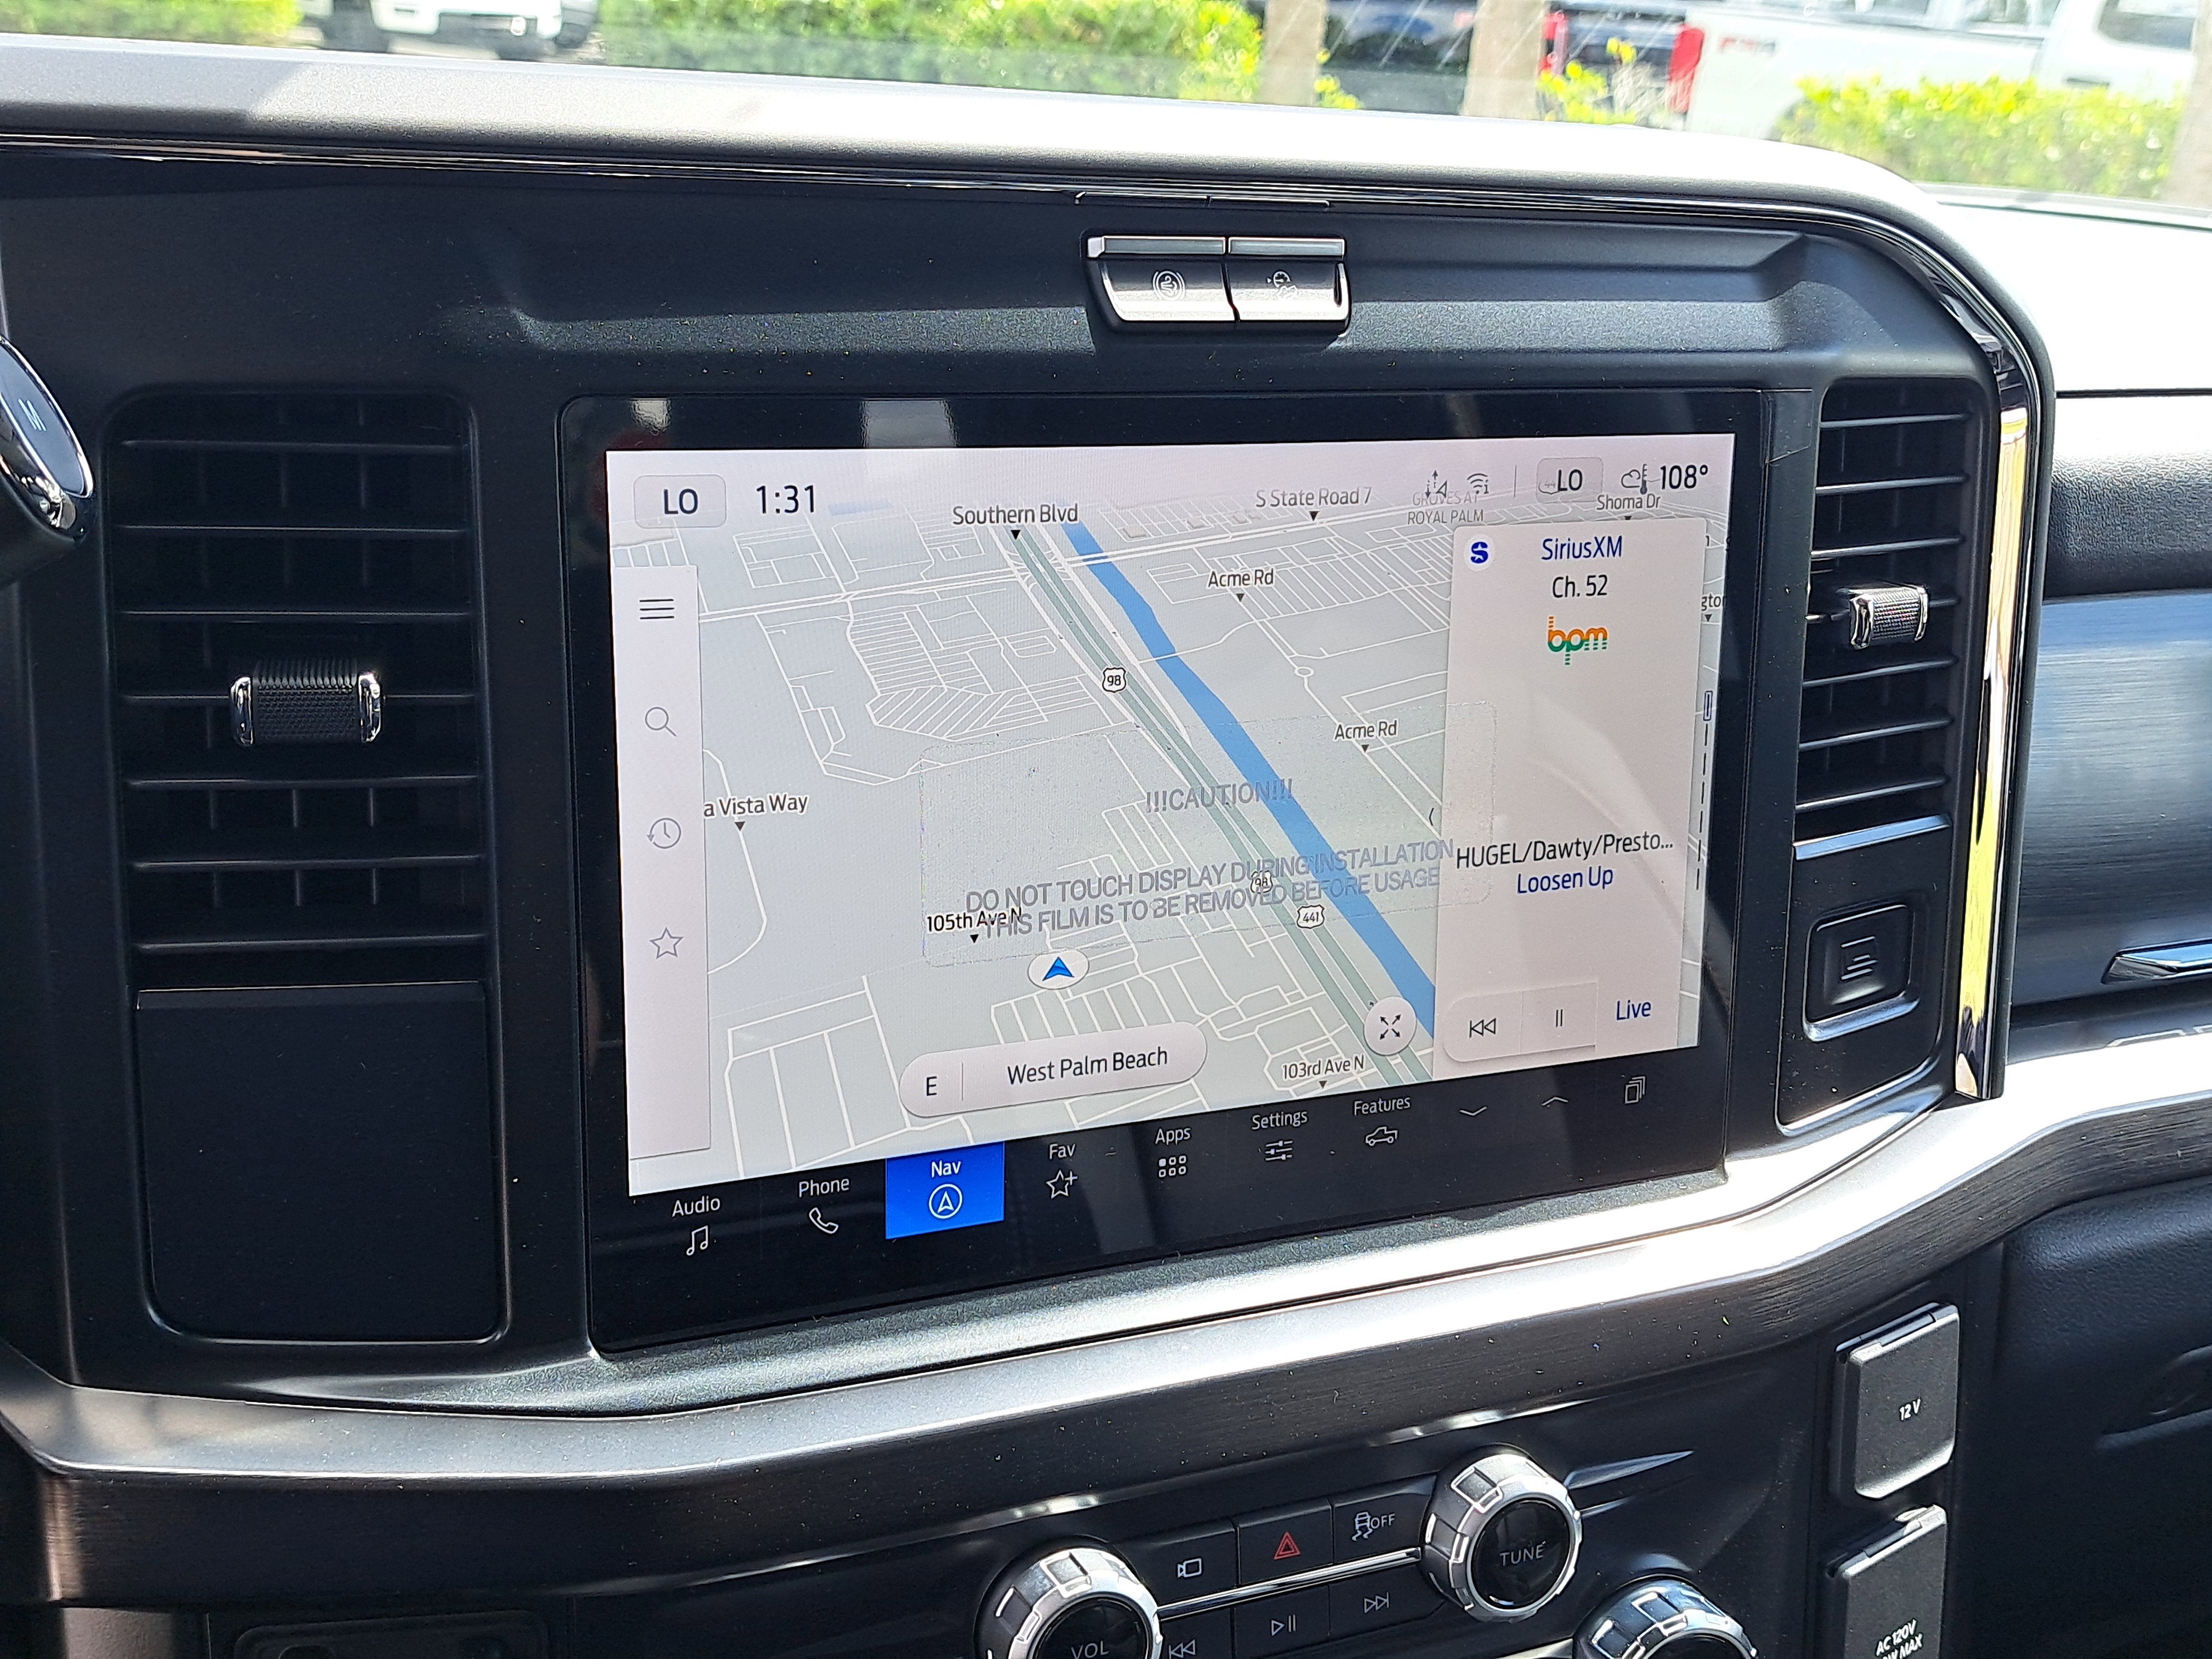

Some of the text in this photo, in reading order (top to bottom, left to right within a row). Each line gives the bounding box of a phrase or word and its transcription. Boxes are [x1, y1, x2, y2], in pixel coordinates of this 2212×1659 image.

[1557, 469, 1583, 491] LO
[664, 489, 698, 515] LO
[756, 485, 817, 514] 1:31
[1256, 487, 1371, 507] S State Road 7
[1413, 493, 1461, 506] GROVES
[1597, 494, 1660, 510] Shoma Dr
[952, 504, 1078, 525] Southern Blvd
[1407, 510, 1483, 524] ROYAL PALM
[1541, 535, 1623, 560] SiriusXM
[1208, 568, 1274, 587] Acme Rd
[1552, 575, 1607, 597] Ch. 52
[1548, 616, 1608, 665] bpm
[1107, 675, 1121, 687] 98
[1335, 720, 1397, 740] Acme Rd
[719, 797, 765, 815] Vista
[770, 794, 808, 814] Way
[1147, 778, 1292, 812] !!!CAUTION!!!
[966, 839, 1453, 913] DO NOT TOUCH DISPLAY DURING INSTALLATION
[1254, 877, 1268, 888] 98
[1517, 866, 1613, 894] Loosen Up
[984, 867, 1440, 938] THIS FILM IS TO BE REMOVED BEFORE USAGE
[927, 907, 1022, 932] 105th Ave N
[1302, 912, 1319, 923] 441
[1616, 999, 1652, 1020] Live
[1008, 1047, 1167, 1084] West Palm Beach
[1283, 1056, 1364, 1078] 103rd Ave N
[926, 1076, 937, 1096] E
[1354, 1095, 1411, 1116] Features
[1251, 1110, 1308, 1130] Settings
[1155, 1126, 1191, 1146] Apps
[1049, 1143, 1076, 1160] Fav
[930, 1160, 961, 1177] Nav
[798, 1175, 850, 1198] Phone
[673, 1195, 720, 1218] Audio
[1371, 1513, 1394, 1529] OFF
[1500, 1546, 1545, 1566] TUNE
[1071, 1640, 1109, 1659] VOL
[1876, 1636, 1891, 1656] AC
[1900, 1633, 1923, 1659] MAX
